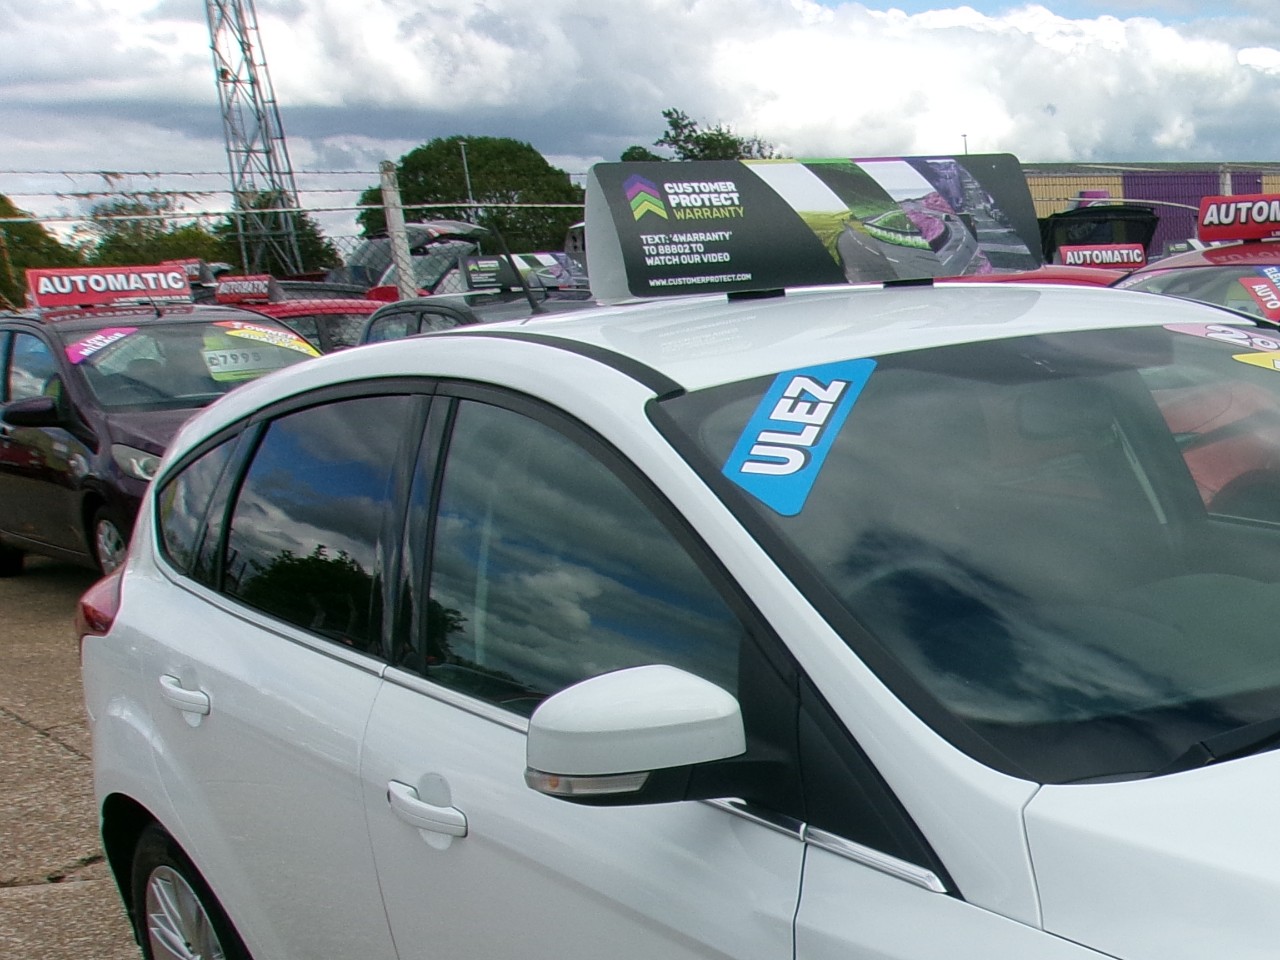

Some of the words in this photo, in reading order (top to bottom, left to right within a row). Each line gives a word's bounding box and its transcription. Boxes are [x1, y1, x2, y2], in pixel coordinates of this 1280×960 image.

[663, 182, 737, 193] CUSTOMER
[668, 193, 740, 207] PROTECT
[673, 207, 744, 220] WARRANTY
[640, 234, 669, 244] TEXT:
[643, 246, 657, 255] TO
[659, 244, 690, 255] 88802
[691, 243, 704, 253] TO
[645, 256, 680, 266] WATCH
[682, 254, 701, 264] OUR
[701, 253, 730, 263] VIDEO
[1066, 249, 1142, 264] AUTOMATIC
[38, 271, 185, 295] AUTOMATIC
[649, 273, 752, 287] WWW.CUSTOMERPROTECT.COM
[80, 334, 106, 347] LOW
[1205, 325, 1253, 348] 2
[740, 375, 850, 477] ULEZ
